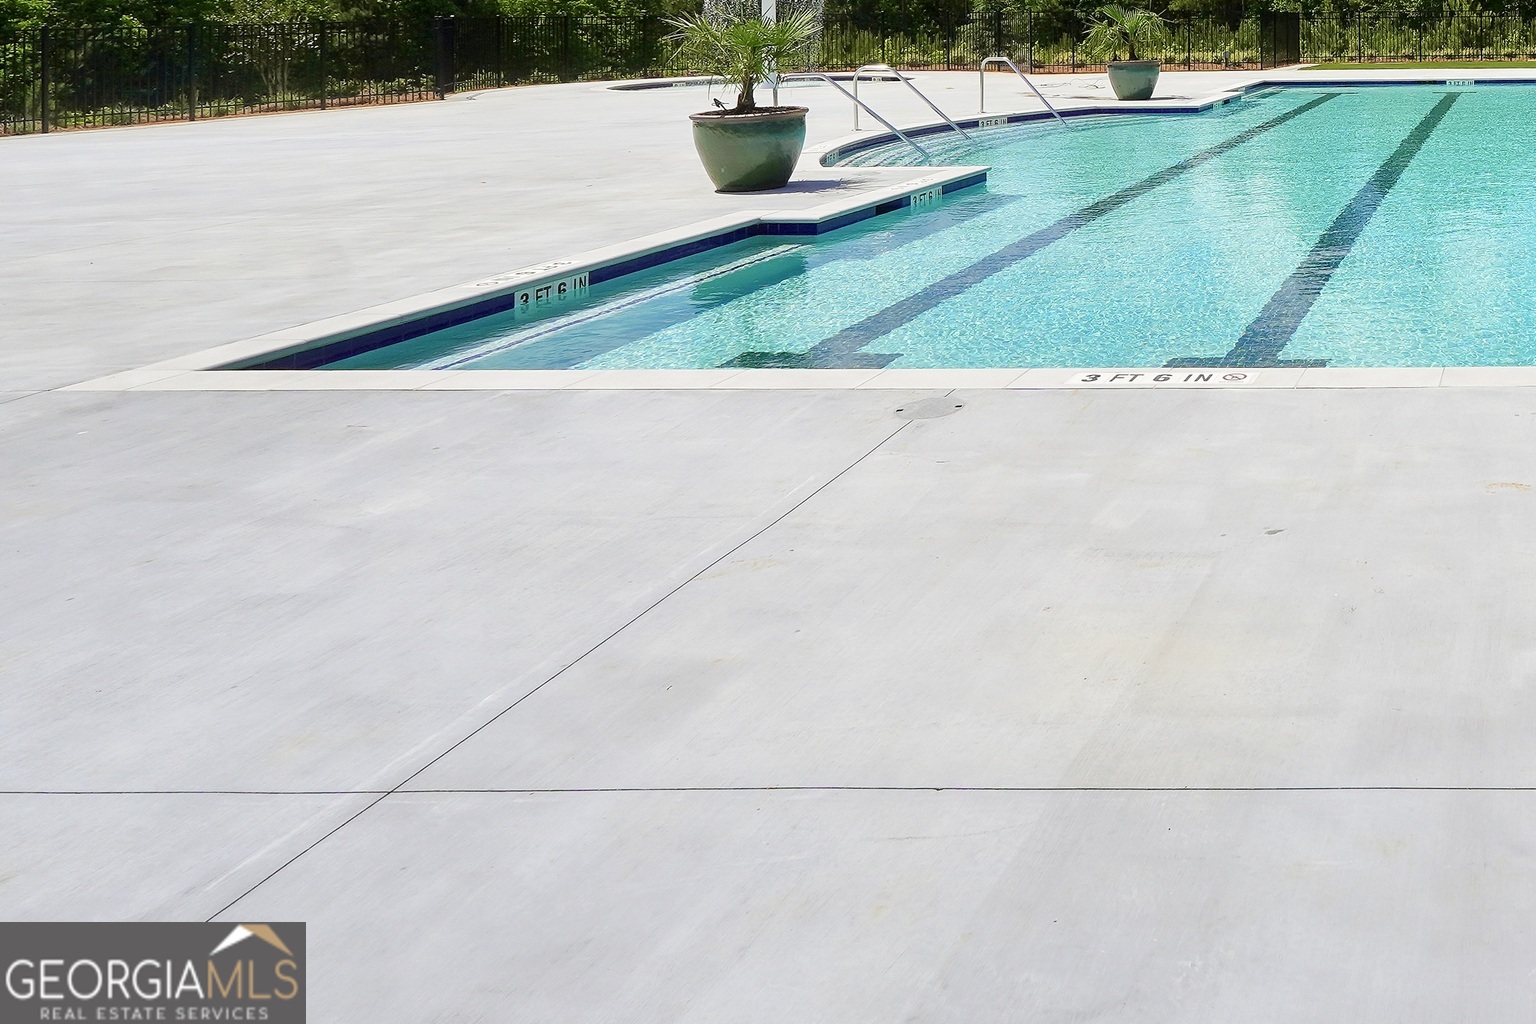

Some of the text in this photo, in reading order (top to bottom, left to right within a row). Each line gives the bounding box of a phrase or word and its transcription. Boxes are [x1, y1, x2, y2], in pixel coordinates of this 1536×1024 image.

[520, 275, 587, 305] 3 FT 6 IN
[1080, 373, 1214, 383] 3 FT 6 IN
